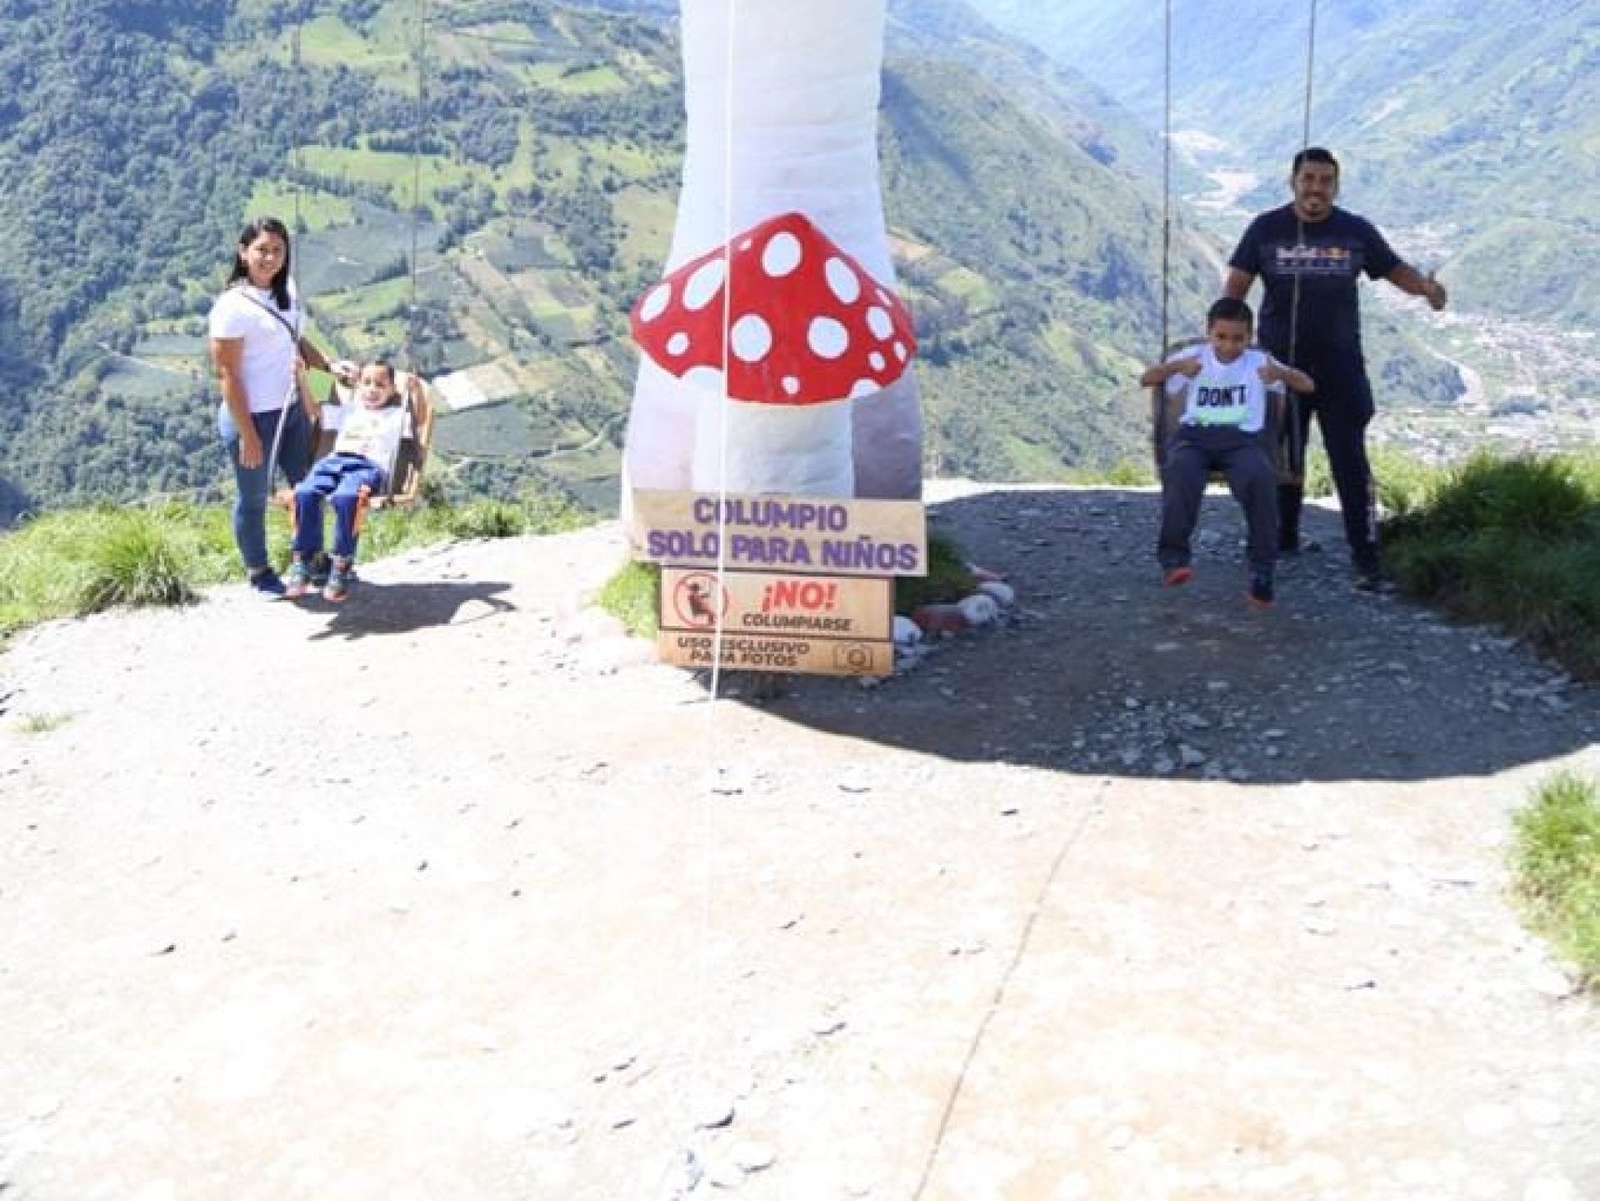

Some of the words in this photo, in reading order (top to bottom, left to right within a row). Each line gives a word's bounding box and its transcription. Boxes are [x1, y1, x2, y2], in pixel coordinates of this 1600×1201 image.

[1198, 384, 1246, 407] DON'T
[694, 497, 848, 532] COLUMPIO
[648, 530, 719, 558] SOLO
[731, 533, 811, 564] PARA
[821, 534, 919, 570] NIÑOS
[762, 580, 837, 612] ¡NO!
[742, 613, 852, 631] COLUMPIARSE
[677, 637, 712, 649] USO
[741, 652, 797, 666] FOTOS
